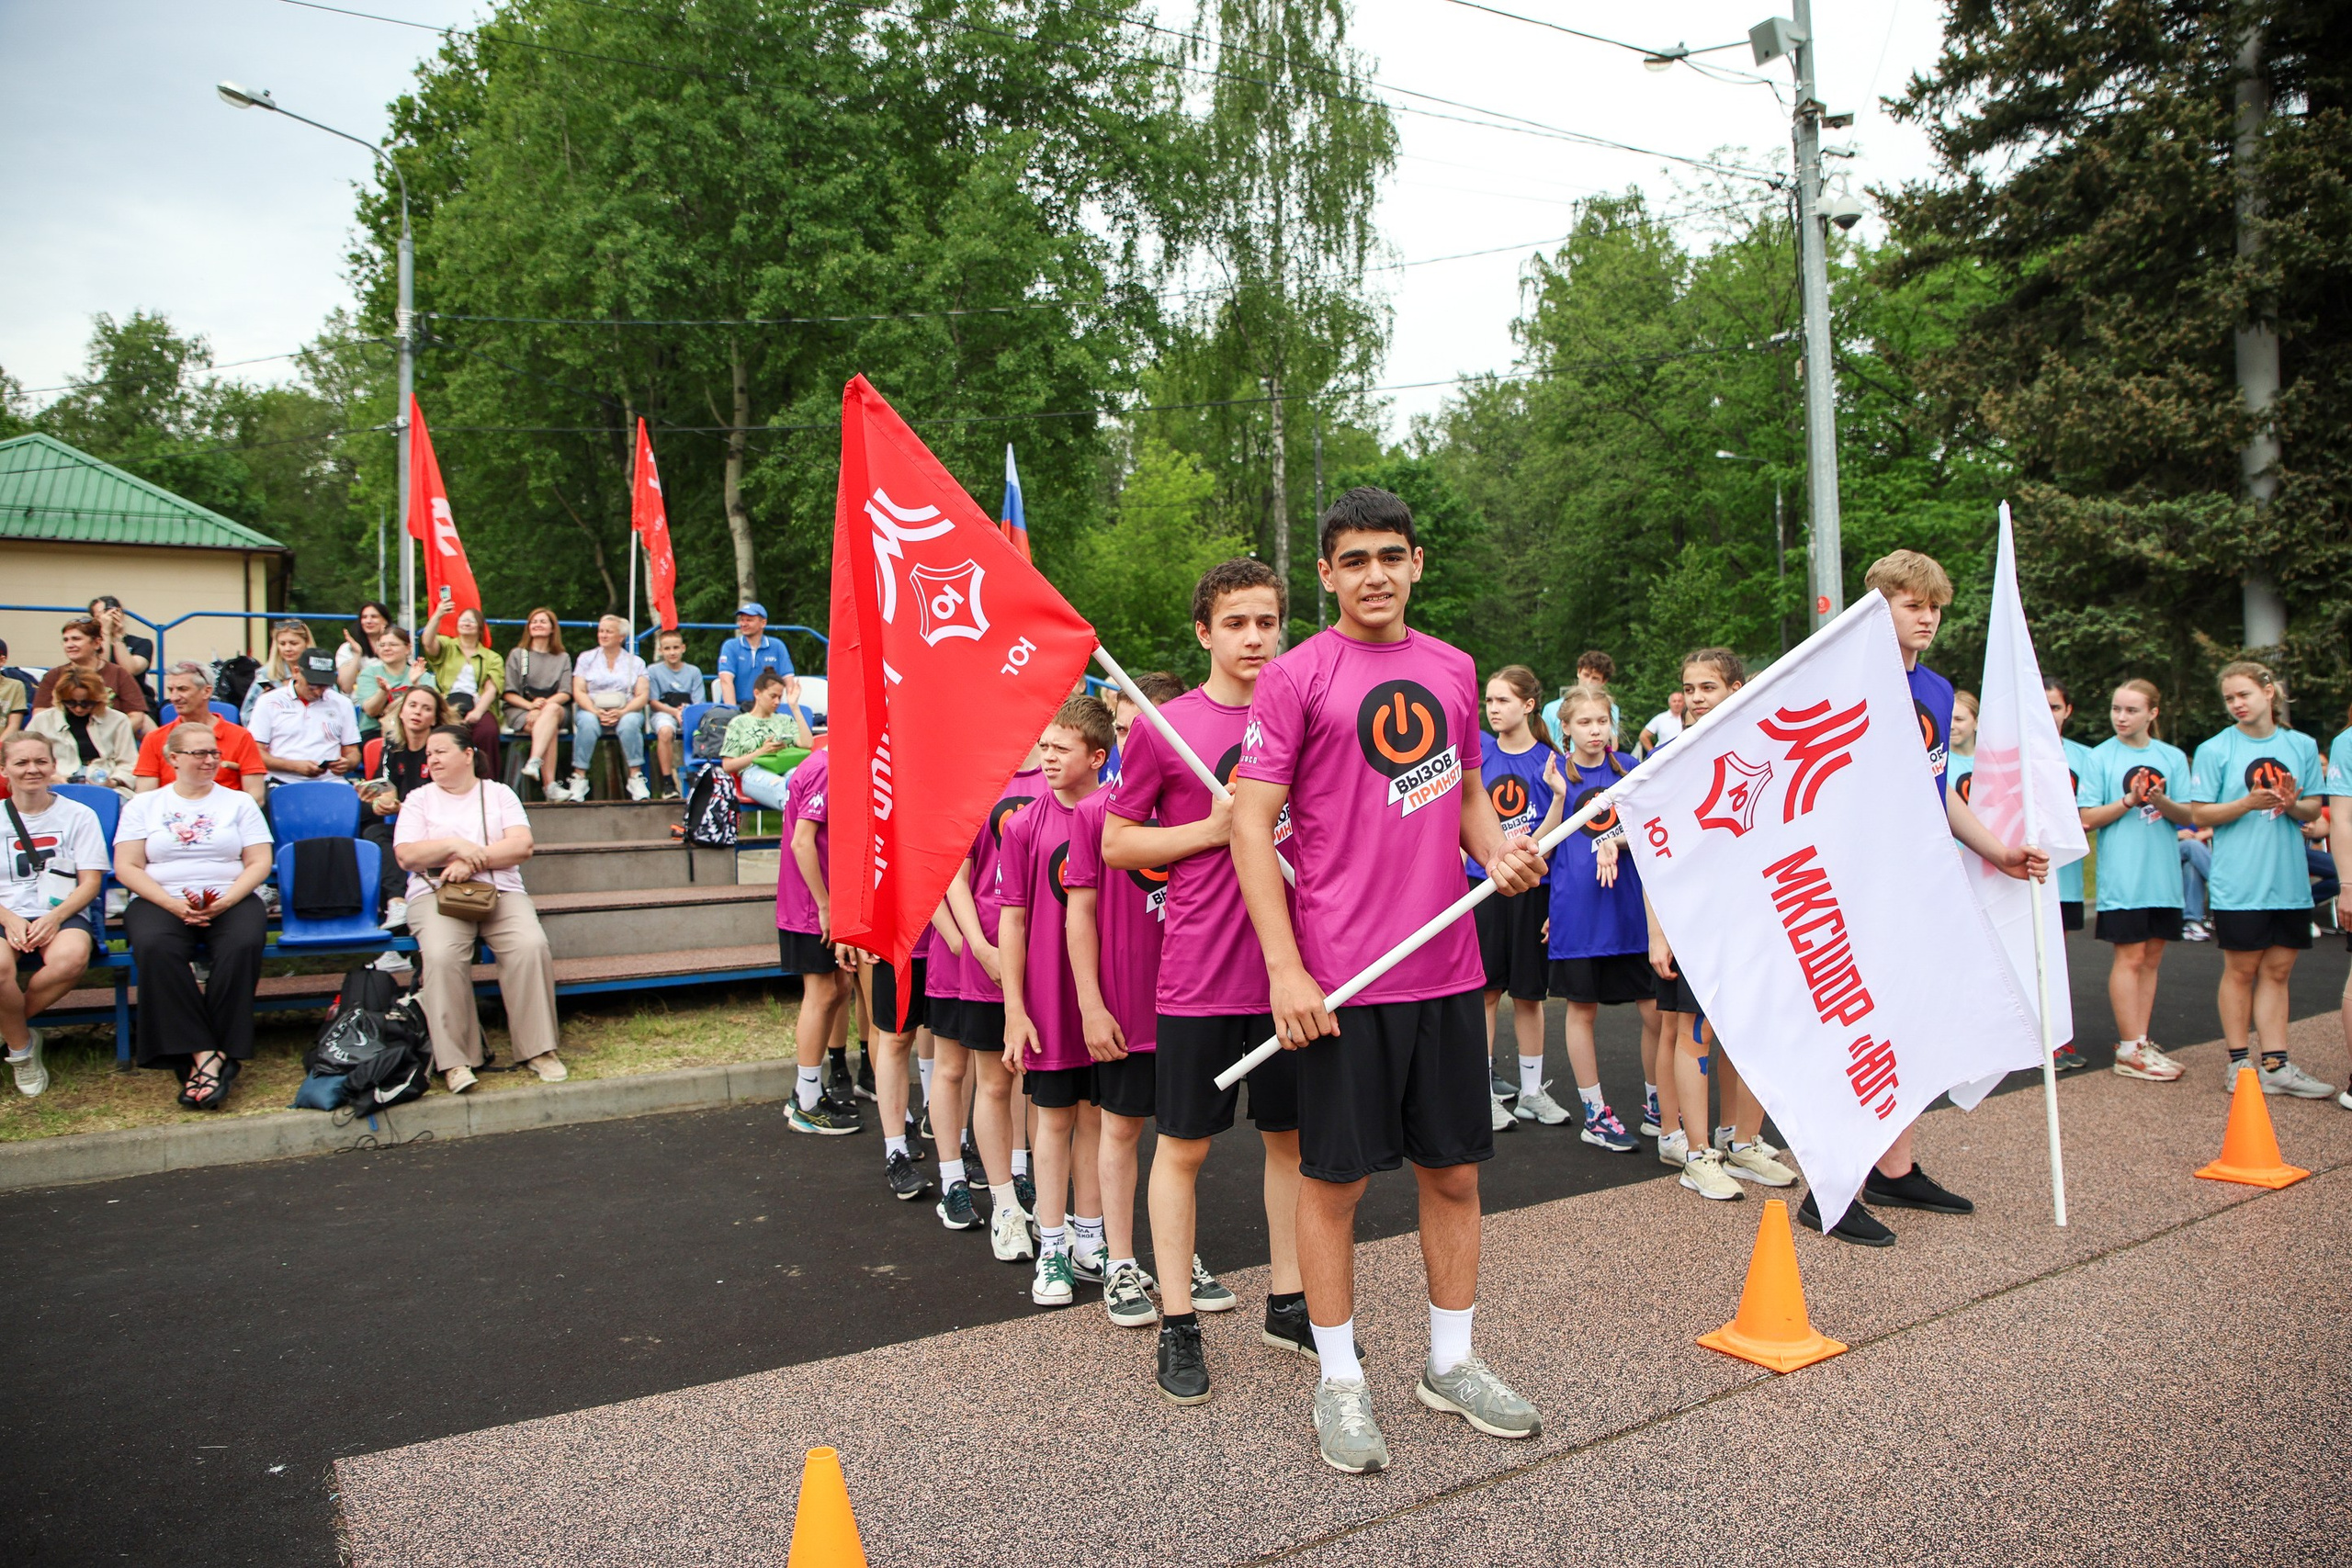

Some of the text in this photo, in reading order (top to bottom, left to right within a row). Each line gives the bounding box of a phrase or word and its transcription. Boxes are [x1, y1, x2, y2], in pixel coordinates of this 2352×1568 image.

[1394, 752, 1453, 795] ВЫЗОВ
[1408, 764, 1461, 808] ПРИНЯТ
[1501, 816, 1528, 831] ВЫЗО
[1507, 825, 1531, 840] ПРИН
[1761, 843, 1875, 1028] МКСШОР
